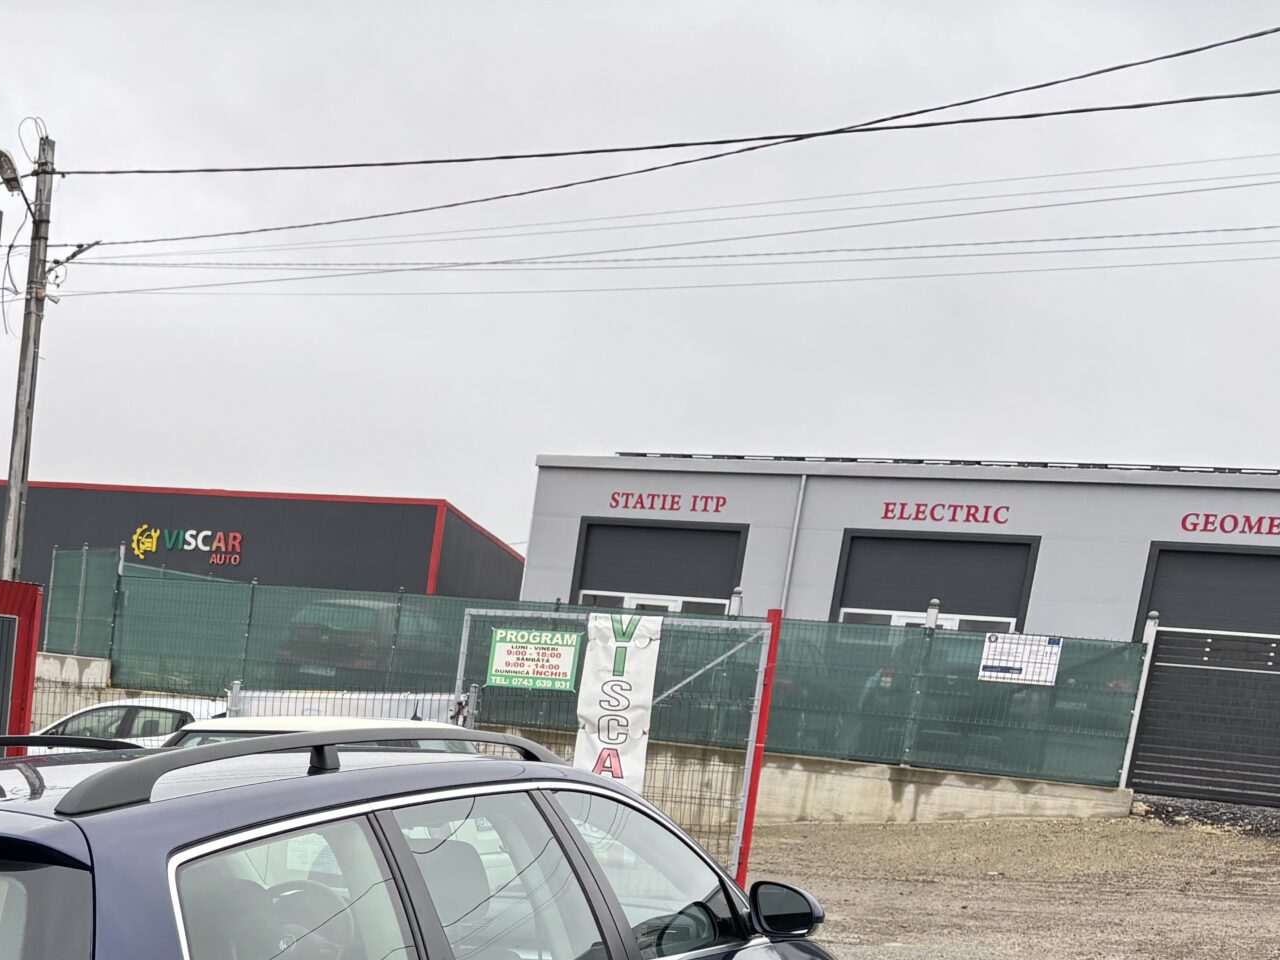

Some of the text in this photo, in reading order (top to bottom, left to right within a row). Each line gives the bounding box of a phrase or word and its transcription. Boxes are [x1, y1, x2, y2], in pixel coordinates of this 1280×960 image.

[609, 491, 728, 513] STATIE ITP
[880, 501, 1010, 525] ELECTRIC
[164, 528, 242, 552] VISCAR
[209, 554, 240, 565] AUTO
[496, 630, 577, 646] PROGRAM
[536, 651, 562, 659] 18:00
[491, 676, 570, 688] TEL: 0743 639 931
